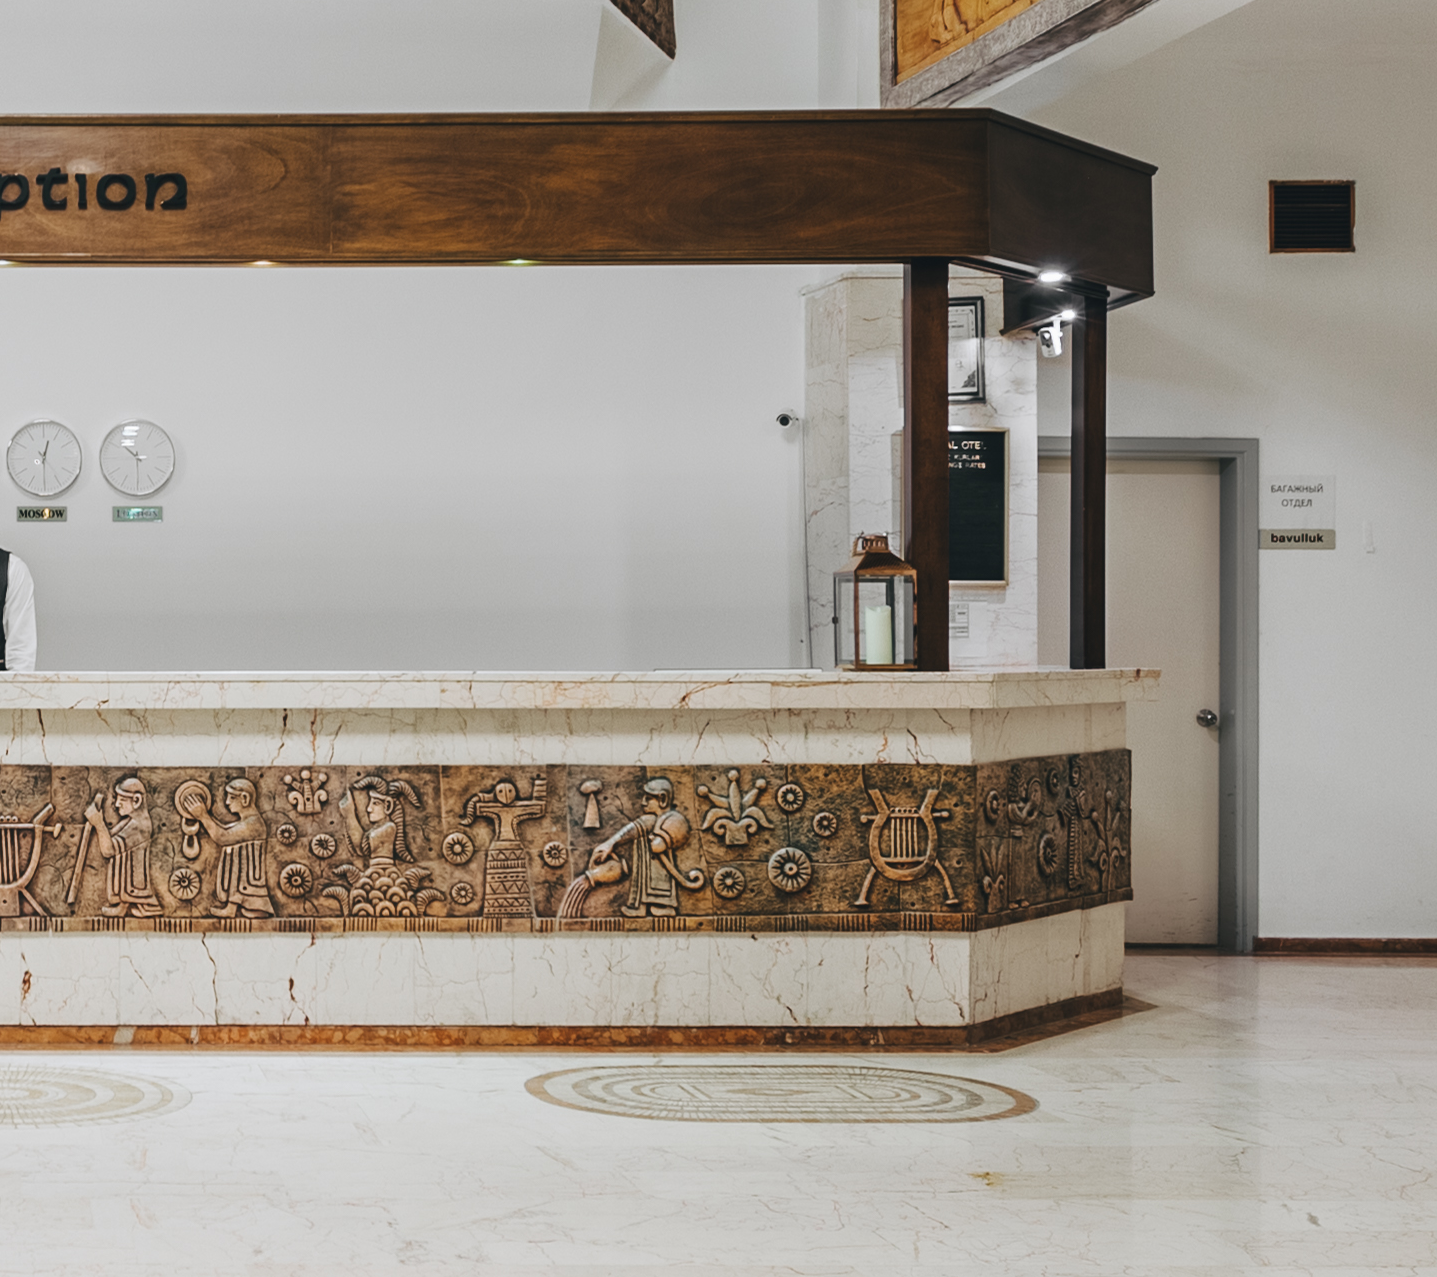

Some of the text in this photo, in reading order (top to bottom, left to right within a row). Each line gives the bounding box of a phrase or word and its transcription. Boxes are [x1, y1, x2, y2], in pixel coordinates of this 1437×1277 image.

[1270, 483, 1324, 494] БАГАЖНЫЙ
[1281, 498, 1313, 509] ОТДЕЛ
[18, 509, 65, 519] MOSCOW
[1270, 533, 1324, 543] bavulluk
